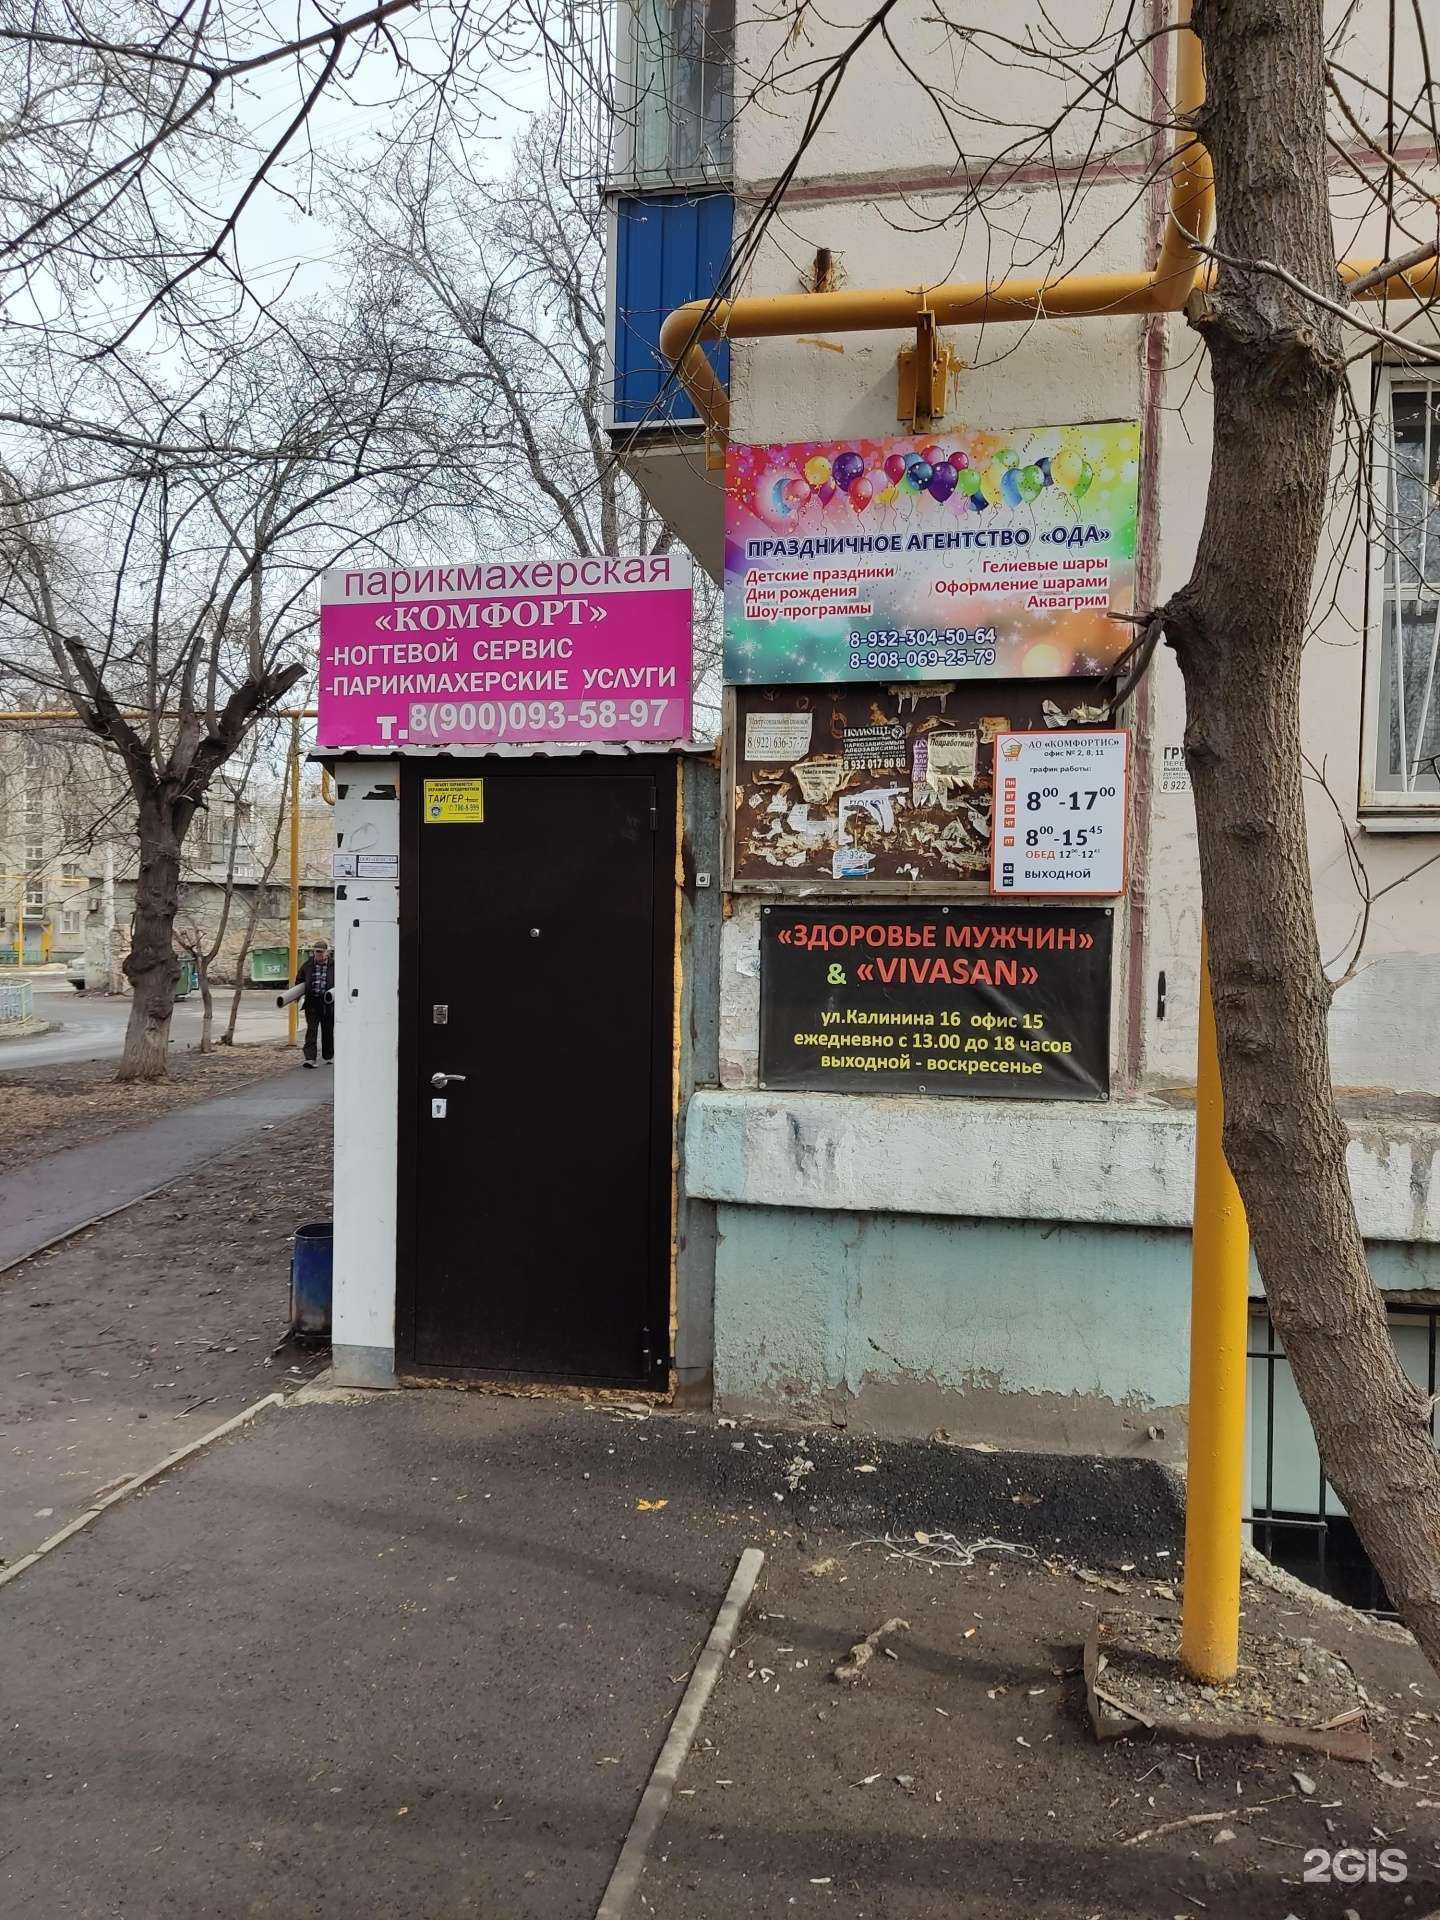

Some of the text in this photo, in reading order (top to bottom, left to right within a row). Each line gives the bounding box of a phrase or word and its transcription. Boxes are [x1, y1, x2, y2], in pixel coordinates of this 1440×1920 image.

[747, 526, 1110, 558] ПРАЗДНИЧНОЕ АГЕНТСТВО «ОДА»
[747, 565, 894, 584] Детские праздники
[983, 557, 1108, 573] Гелиевые шары
[345, 556, 671, 602] парикмахерская
[935, 576, 1108, 596] Оформление шарами
[747, 585, 857, 602] Дни рождения
[1028, 595, 1107, 611] Аквагрим
[375, 599, 608, 632] «КОМФОРТ»
[747, 602, 871, 621] Шоу-программы
[850, 628, 996, 648] 8-932-304-50-64
[473, 637, 573, 661] СЕРВИС
[850, 648, 996, 669] 8-908-069-25-79
[583, 667, 676, 690] УСЛУГИ
[410, 699, 669, 738] 8(900)093-58-97
[1045, 738, 1119, 749] «КОМФОРТИС»
[851, 760, 866, 770] 932
[884, 758, 895, 768] 80
[896, 757, 906, 768] 80
[1044, 750, 1064, 758] офис
[1029, 766, 1058, 774] график
[1025, 850, 1056, 860] ОБЕД
[1024, 868, 1091, 880] ВЫХОДНОЙ
[777, 924, 1095, 951] «ЗДОРОВЬЕ МУЖЧИН»
[826, 957, 1039, 986] & «VIVASAN»
[821, 1009, 1044, 1031] ул.Калинина 16 офис 15
[794, 1033, 1073, 1053] ежедневно с 13.00 до 18 часов
[821, 1053, 911, 1071] выходной
[927, 1057, 1043, 1075] воскресенье
